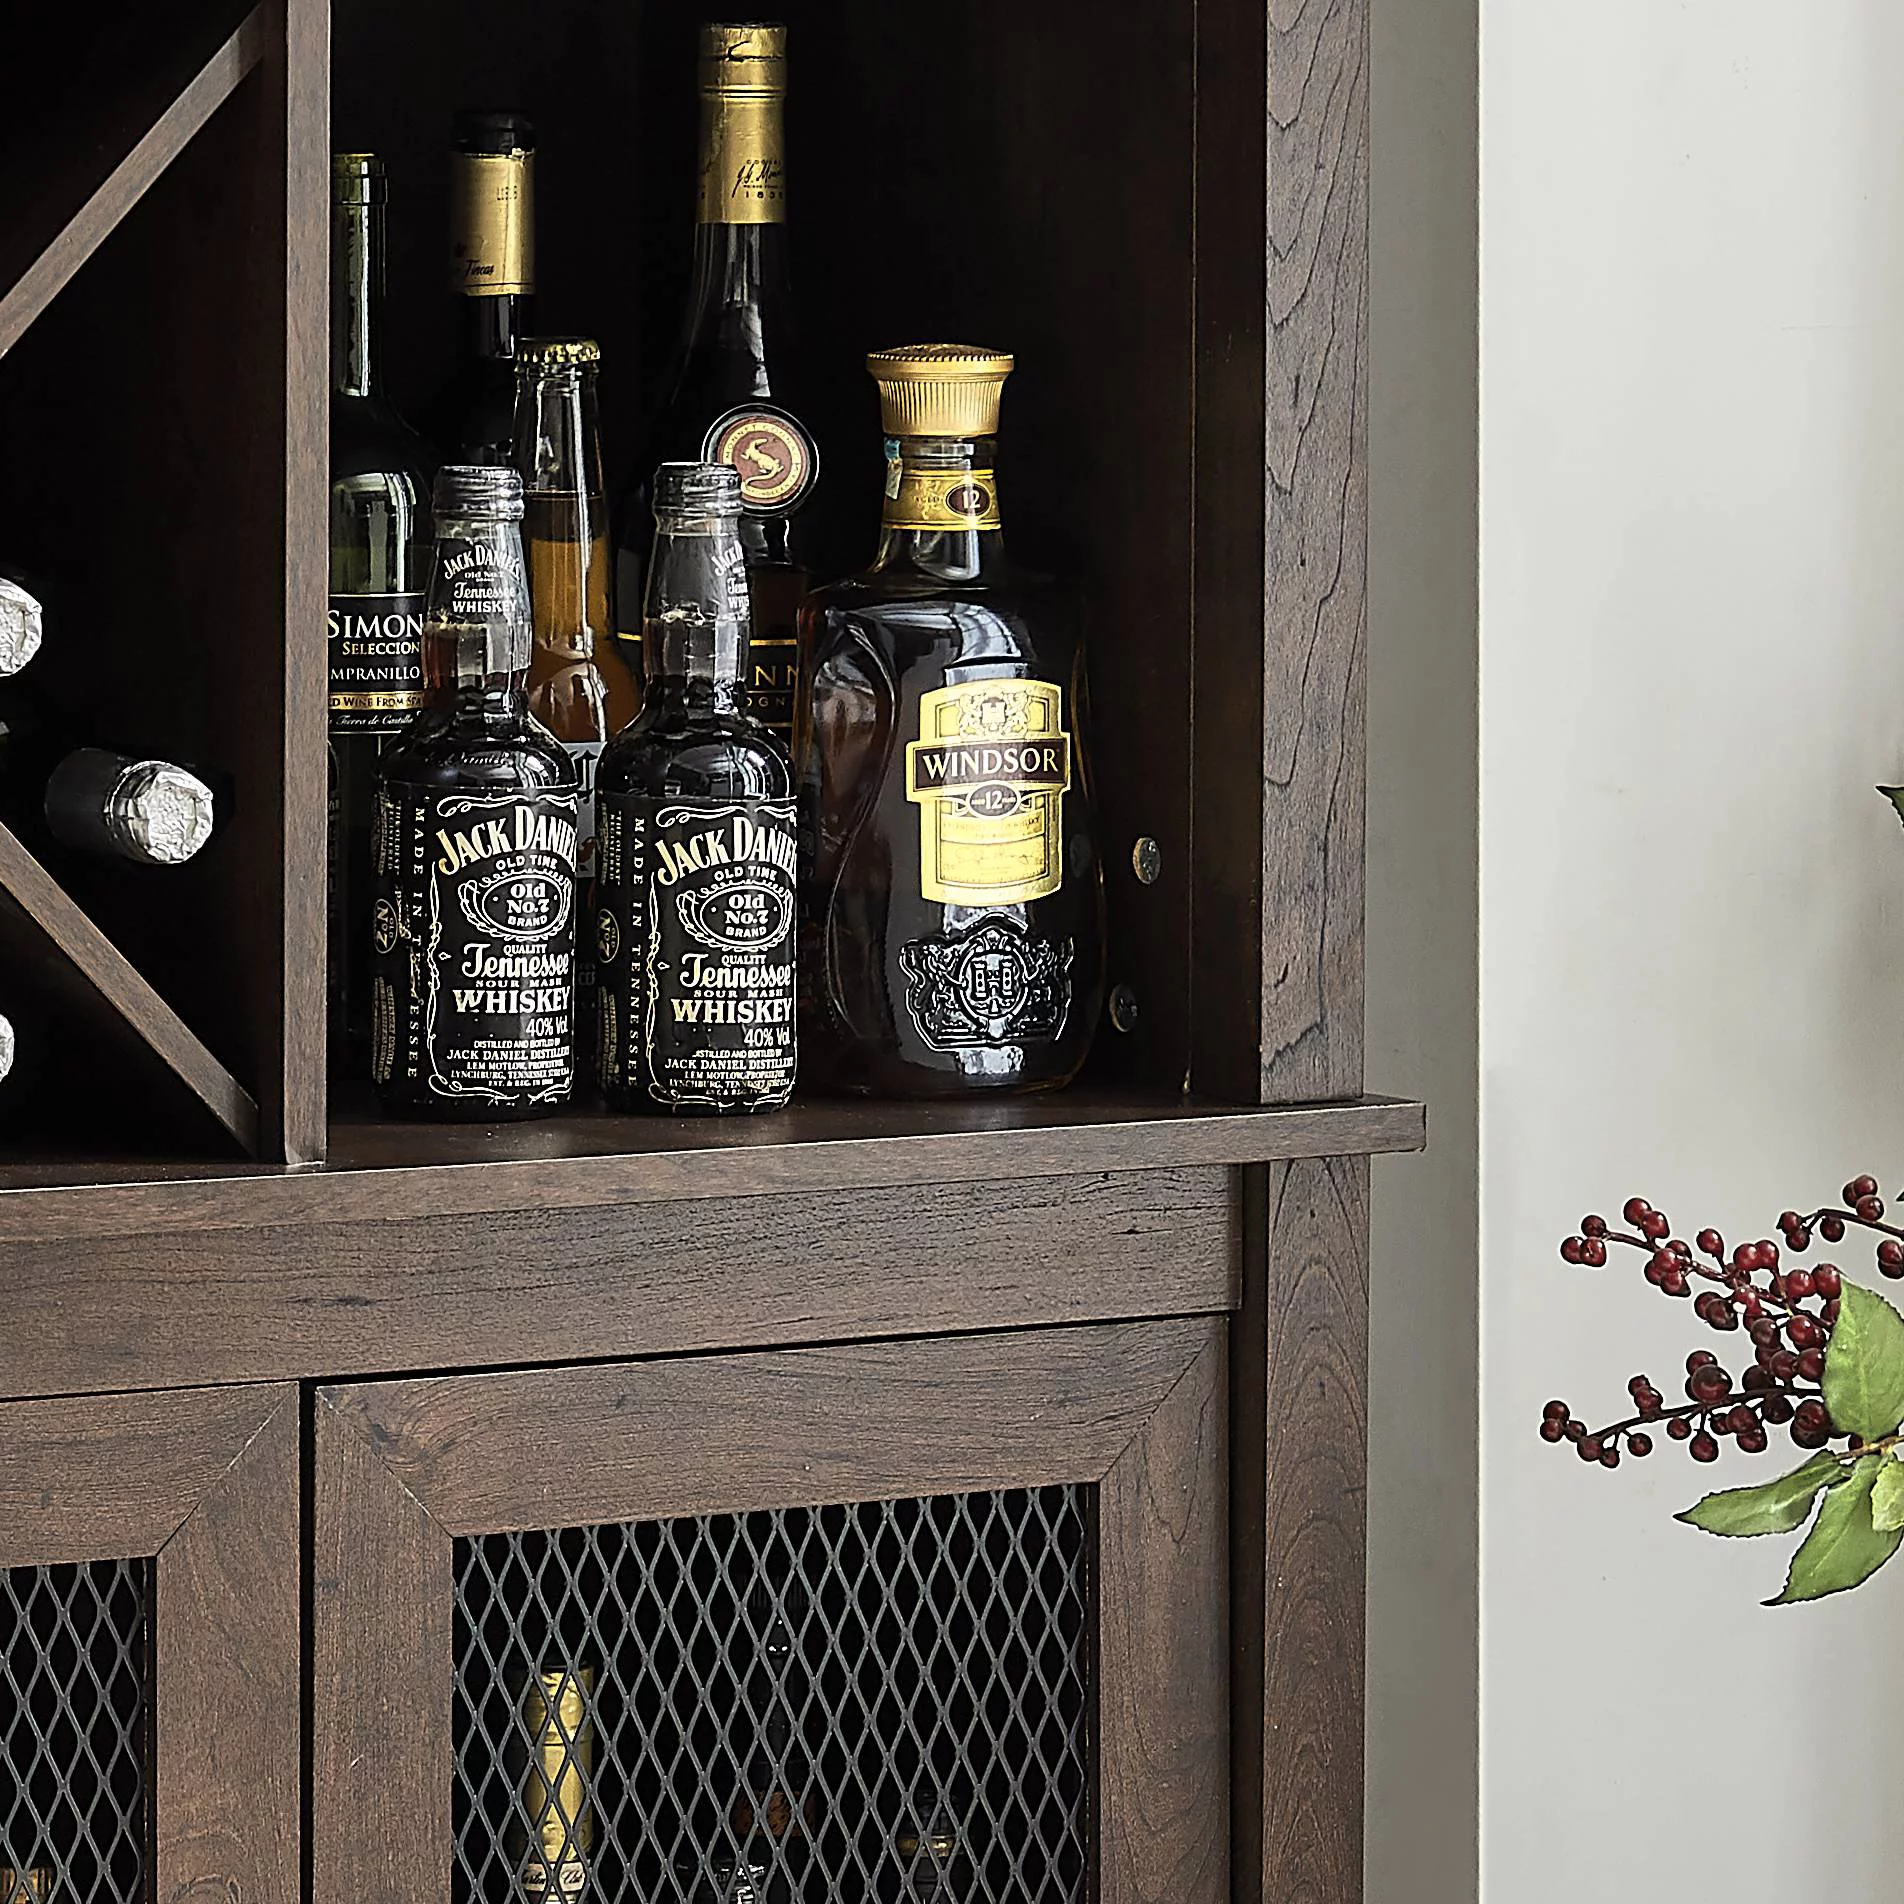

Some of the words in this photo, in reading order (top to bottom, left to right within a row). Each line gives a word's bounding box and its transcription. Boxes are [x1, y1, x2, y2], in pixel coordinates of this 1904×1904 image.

[962, 489, 981, 509] 12
[443, 550, 475, 580] JACK
[453, 581, 516, 599] Tennessee
[452, 600, 517, 613] WHISKEY
[330, 666, 421, 680] MPRANILLO
[922, 747, 1058, 780] WINDSOR
[985, 790, 1003, 810] 12
[413, 807, 426, 875] MADE
[435, 817, 513, 875] JACK
[633, 817, 645, 885] MADE
[655, 828, 732, 886] JACK
[495, 855, 526, 871] OLD
[529, 854, 559, 870] TIME
[714, 866, 744, 882] OLD
[747, 865, 777, 881] TIME
[509, 882, 546, 899] Old
[412, 892, 424, 918] IN
[506, 898, 550, 914] No.7
[728, 893, 765, 909] Old
[507, 915, 548, 927] BRAND
[632, 902, 643, 928] IN
[724, 910, 769, 925] No.7
[725, 926, 767, 938] BRAND
[503, 944, 548, 957] QUALITY
[461, 943, 570, 978] Tennessee
[721, 954, 767, 968] QUALITY
[679, 953, 792, 988] Tennessee
[475, 979, 520, 988] SOUR
[529, 977, 562, 988] MASH
[452, 985, 571, 1014] WHISKEY
[693, 989, 739, 999] SOUR
[747, 988, 783, 998] MASH
[627, 944, 641, 1086] TENNESSEE
[670, 998, 793, 1024] WHISKEY
[525, 1016, 553, 1037] 40%
[743, 1027, 774, 1047] 40%
[446, 1050, 479, 1060] JACK
[482, 1050, 528, 1060] DANIEL
[664, 1058, 697, 1070] JACK
[700, 1059, 746, 1070] DANIEL
